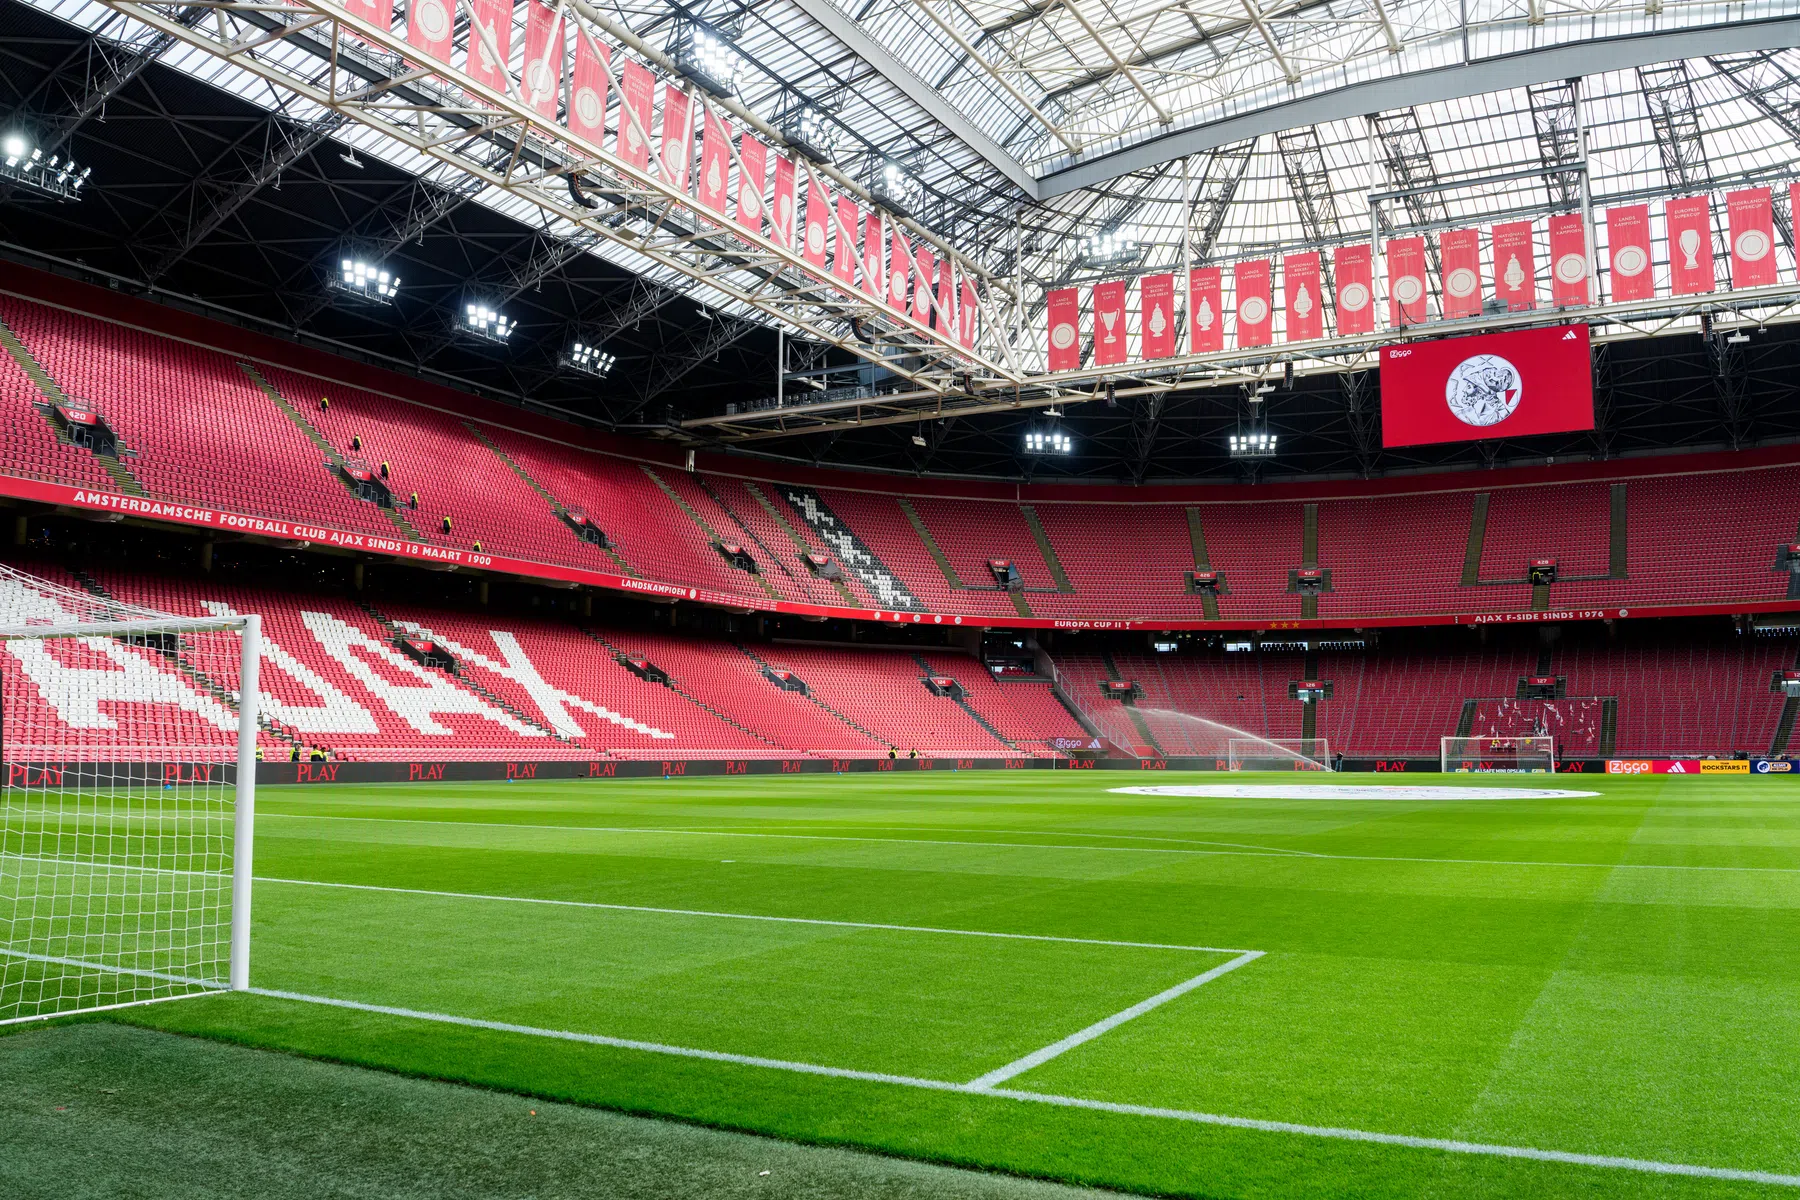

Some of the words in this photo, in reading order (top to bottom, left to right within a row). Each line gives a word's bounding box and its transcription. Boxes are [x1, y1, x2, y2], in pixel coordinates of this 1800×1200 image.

[1729, 197, 1768, 207] NEDERLANDSE
[1736, 203, 1763, 211] SUPERCUP
[1674, 206, 1700, 215] EUROPESE
[1674, 211, 1701, 220] SUPERCUP
[1497, 231, 1526, 239] NATIONALE
[1288, 261, 1314, 269] NATIONALE
[69, 411, 86, 421] 420
[73, 490, 212, 523] AMSTERDAMSCHE
[219, 513, 289, 535] FOOTBALL
[293, 526, 326, 540] CLUB
[330, 532, 363, 547] AJAX
[367, 538, 401, 552] SINDS
[405, 543, 418, 554] 18
[422, 547, 462, 561] MAART
[467, 553, 492, 566] 1900
[621, 579, 687, 596] LANDSKAMPIOEN
[1474, 614, 1503, 624] AJAX
[1506, 613, 1539, 621] F-SIDE
[1542, 612, 1574, 621] SINDS
[1578, 611, 1604, 619] 1976
[1054, 620, 1090, 628] EUROPA
[589, 762, 618, 777] PLAY
[661, 761, 687, 776] PLAY
[725, 761, 748, 774] PLAY
[782, 760, 801, 773] PLAY
[832, 760, 851, 772] PLAY
[878, 759, 895, 771] PLAY
[918, 759, 933, 770] PLAY
[957, 759, 974, 769] PLAY
[1005, 759, 1025, 769] PLAY
[1069, 759, 1095, 769] PLAY
[1141, 759, 1168, 770] PLAY
[1294, 760, 1323, 771] PLAY
[1376, 760, 1406, 772] PLAY
[1609, 760, 1649, 775] Ziggo
[8, 764, 67, 786] PLAY
[163, 763, 215, 785] PLAY
[296, 764, 340, 783] PLAY
[409, 763, 446, 781] PLAY
[506, 763, 538, 779] PLAY
